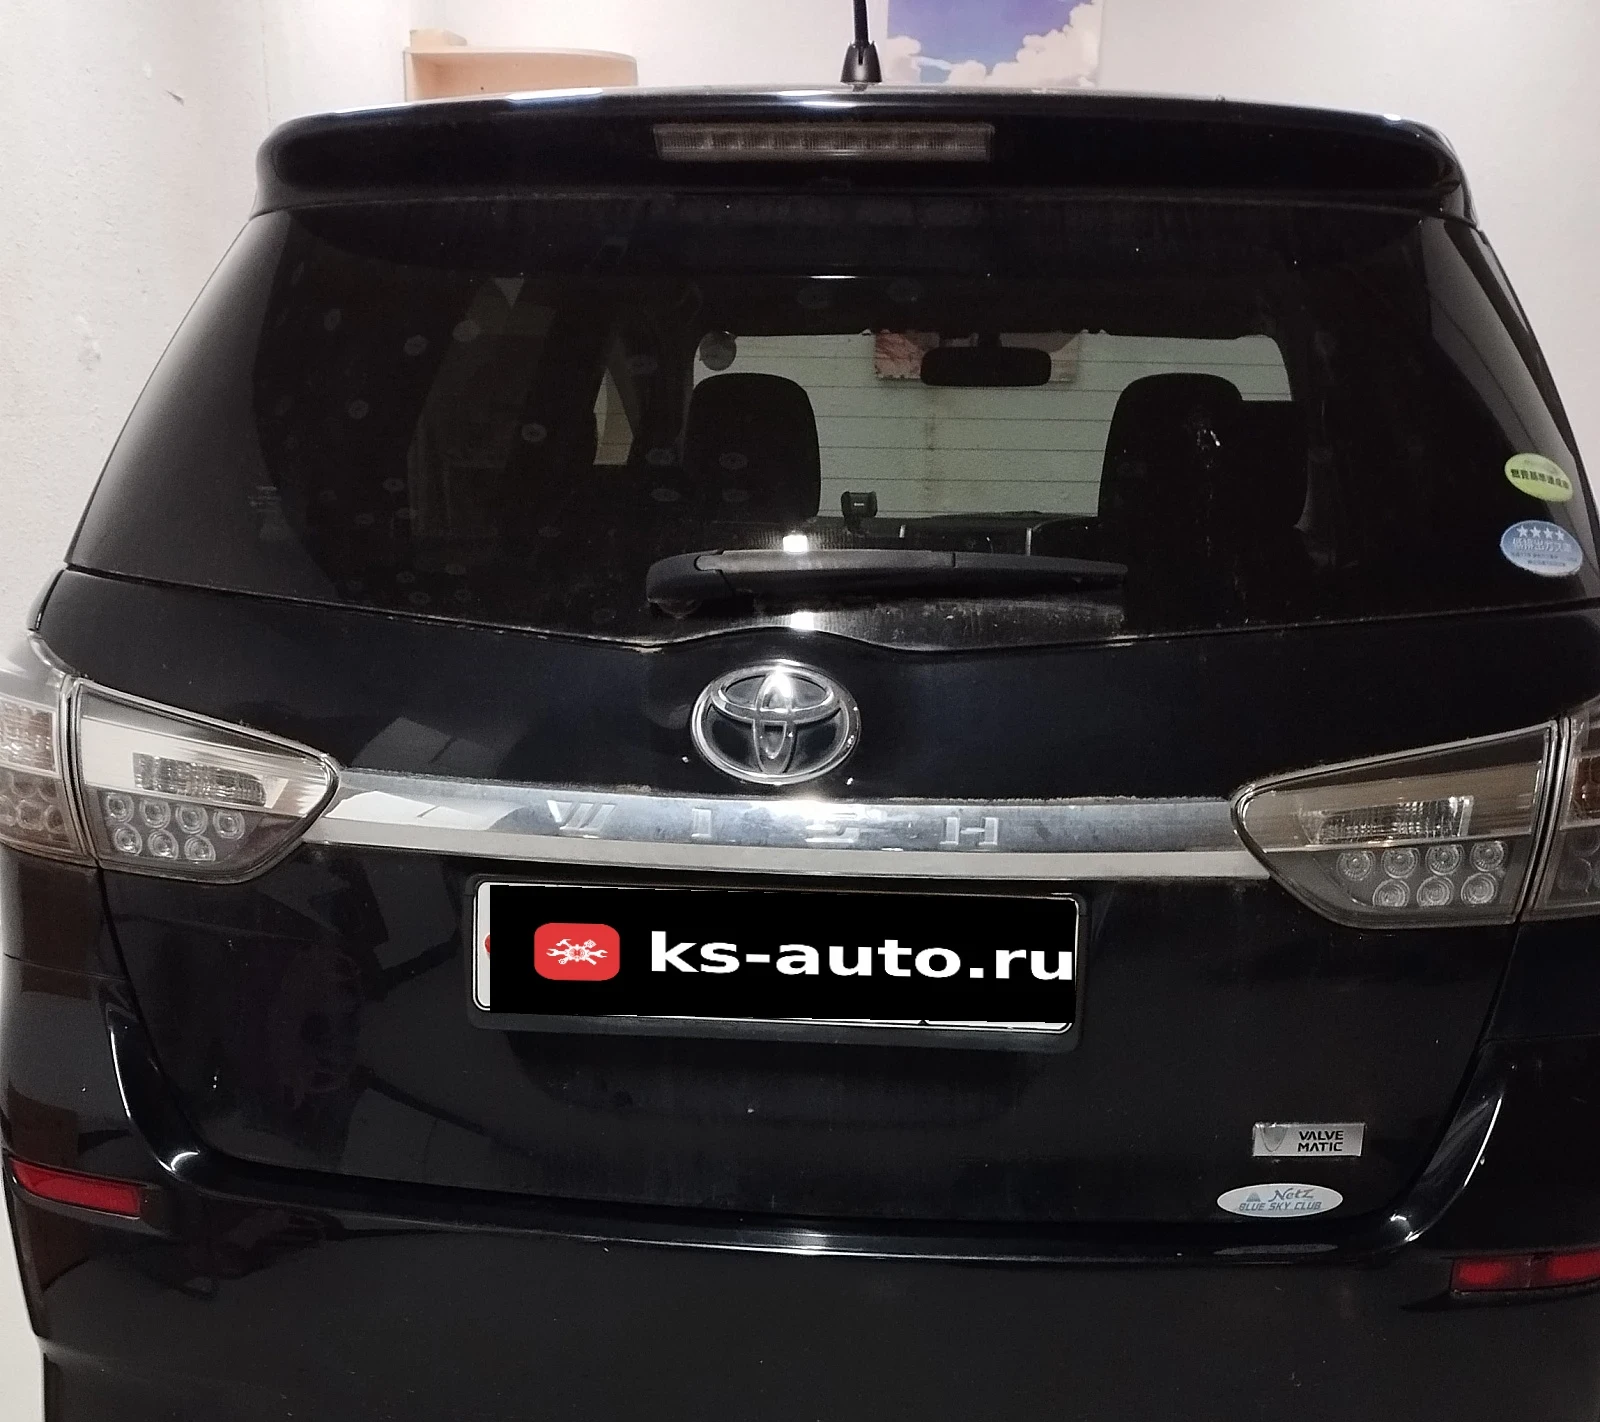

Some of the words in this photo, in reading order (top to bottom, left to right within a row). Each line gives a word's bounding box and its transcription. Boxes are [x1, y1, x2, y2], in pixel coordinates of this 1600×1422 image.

[1299, 1130, 1344, 1141] VALVE
[1297, 1142, 1343, 1152] MATIC
[1268, 1187, 1315, 1202] Netz
[1238, 1202, 1265, 1212] BLUE
[1269, 1202, 1291, 1211] SKY
[1293, 1201, 1322, 1210] CLUB
